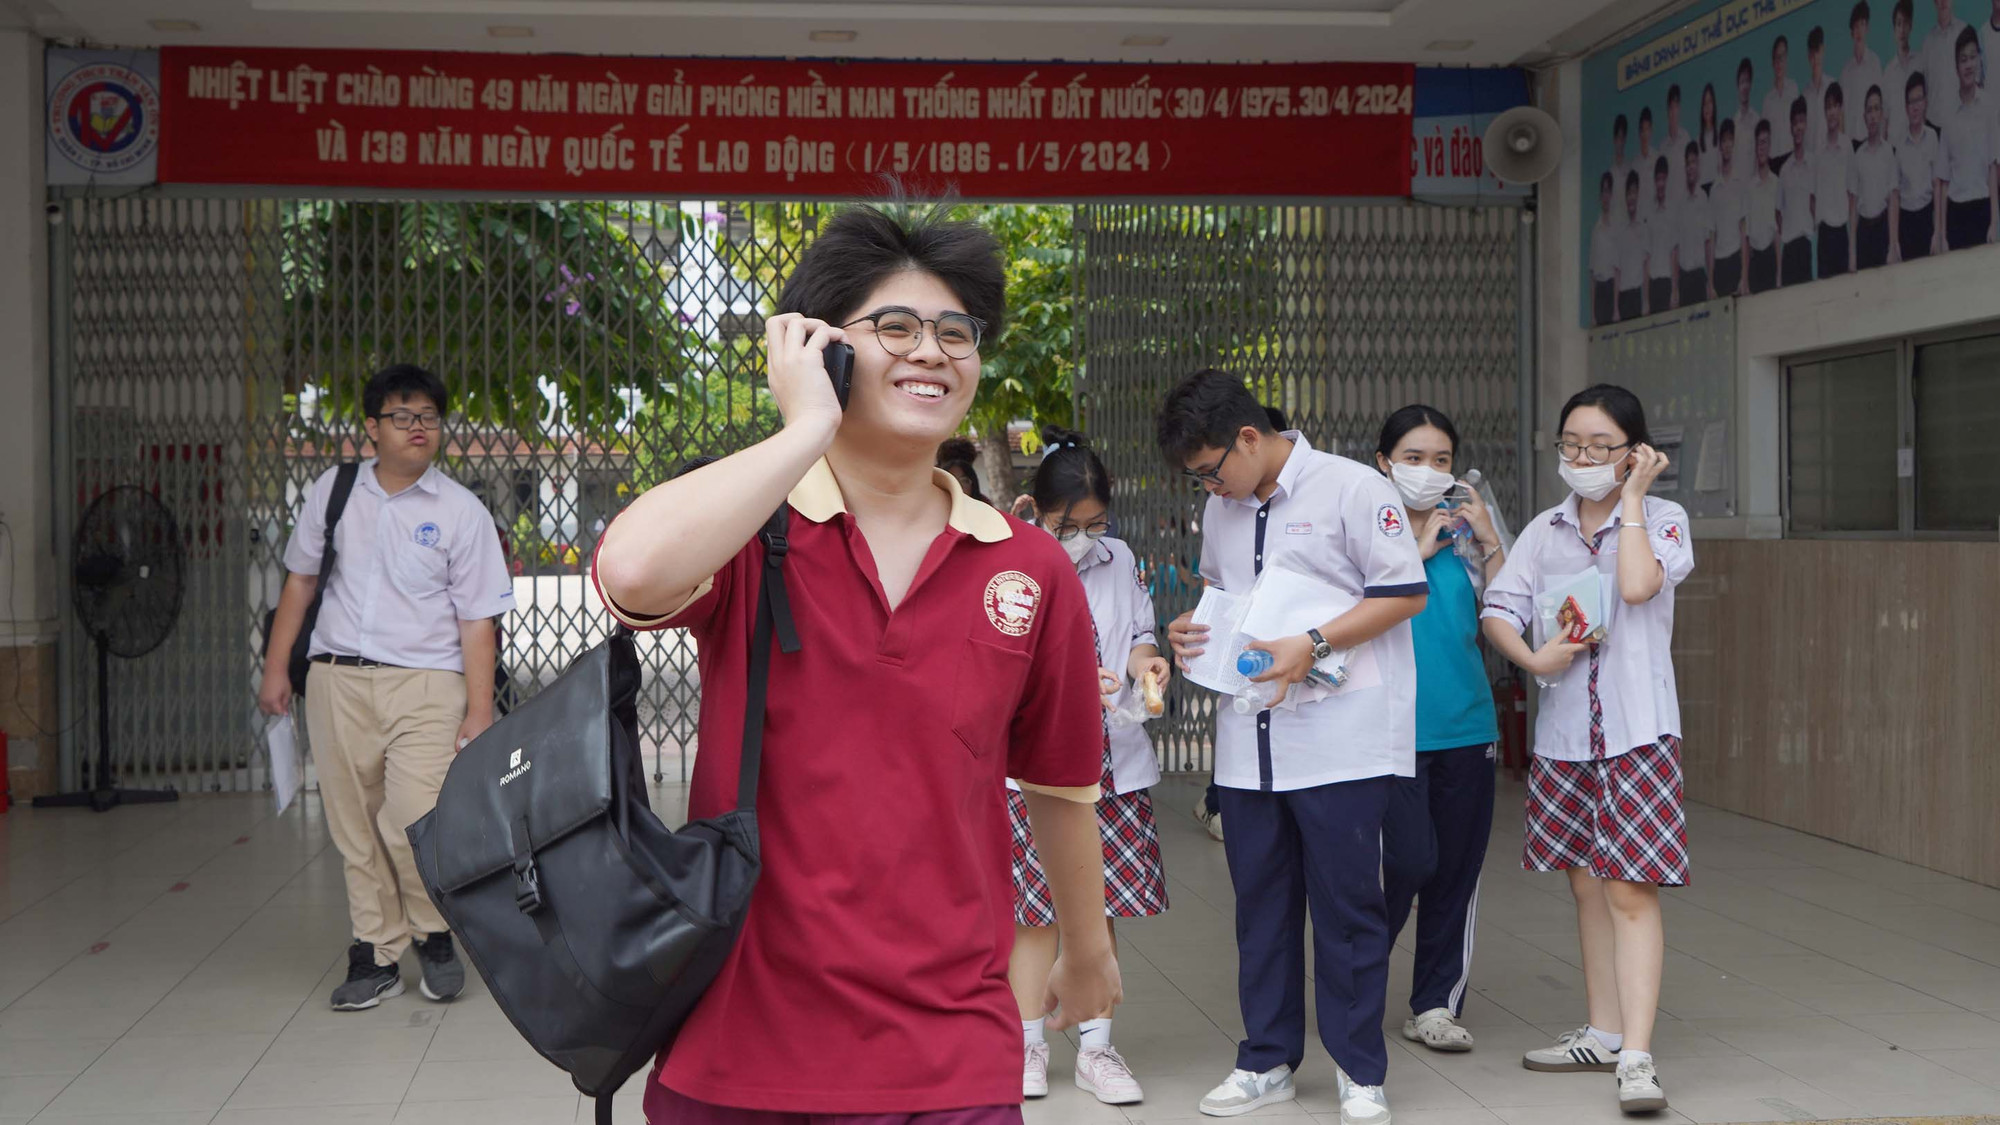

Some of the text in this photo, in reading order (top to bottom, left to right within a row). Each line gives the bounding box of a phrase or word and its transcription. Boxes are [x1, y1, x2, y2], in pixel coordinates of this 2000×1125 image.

[188, 60, 263, 110] NHIỆT
[270, 65, 327, 113] LIỆT
[336, 66, 401, 107] CHÀO
[481, 79, 514, 111] 49
[521, 74, 569, 112] NĂM
[576, 72, 639, 115] NGÀY
[646, 69, 693, 117] GIẢI
[699, 75, 781, 117] PHÓNG
[786, 70, 842, 118] MIỀN
[848, 87, 895, 118] NAM
[902, 72, 980, 119] THỐNG
[987, 72, 1046, 119] NHẤT
[1051, 73, 1095, 119] ĐẤT
[316, 120, 347, 161] VÀ
[361, 131, 407, 164] 138
[482, 125, 551, 168] NGÀY
[563, 123, 635, 177] QUỐC
[649, 123, 690, 172] TẾ
[697, 140, 750, 173] LAO
[765, 135, 835, 182] ĐỘNG
[1423, 123, 1445, 178] và
[1450, 123, 1484, 178] đào
[499, 760, 532, 788] ROMANO
